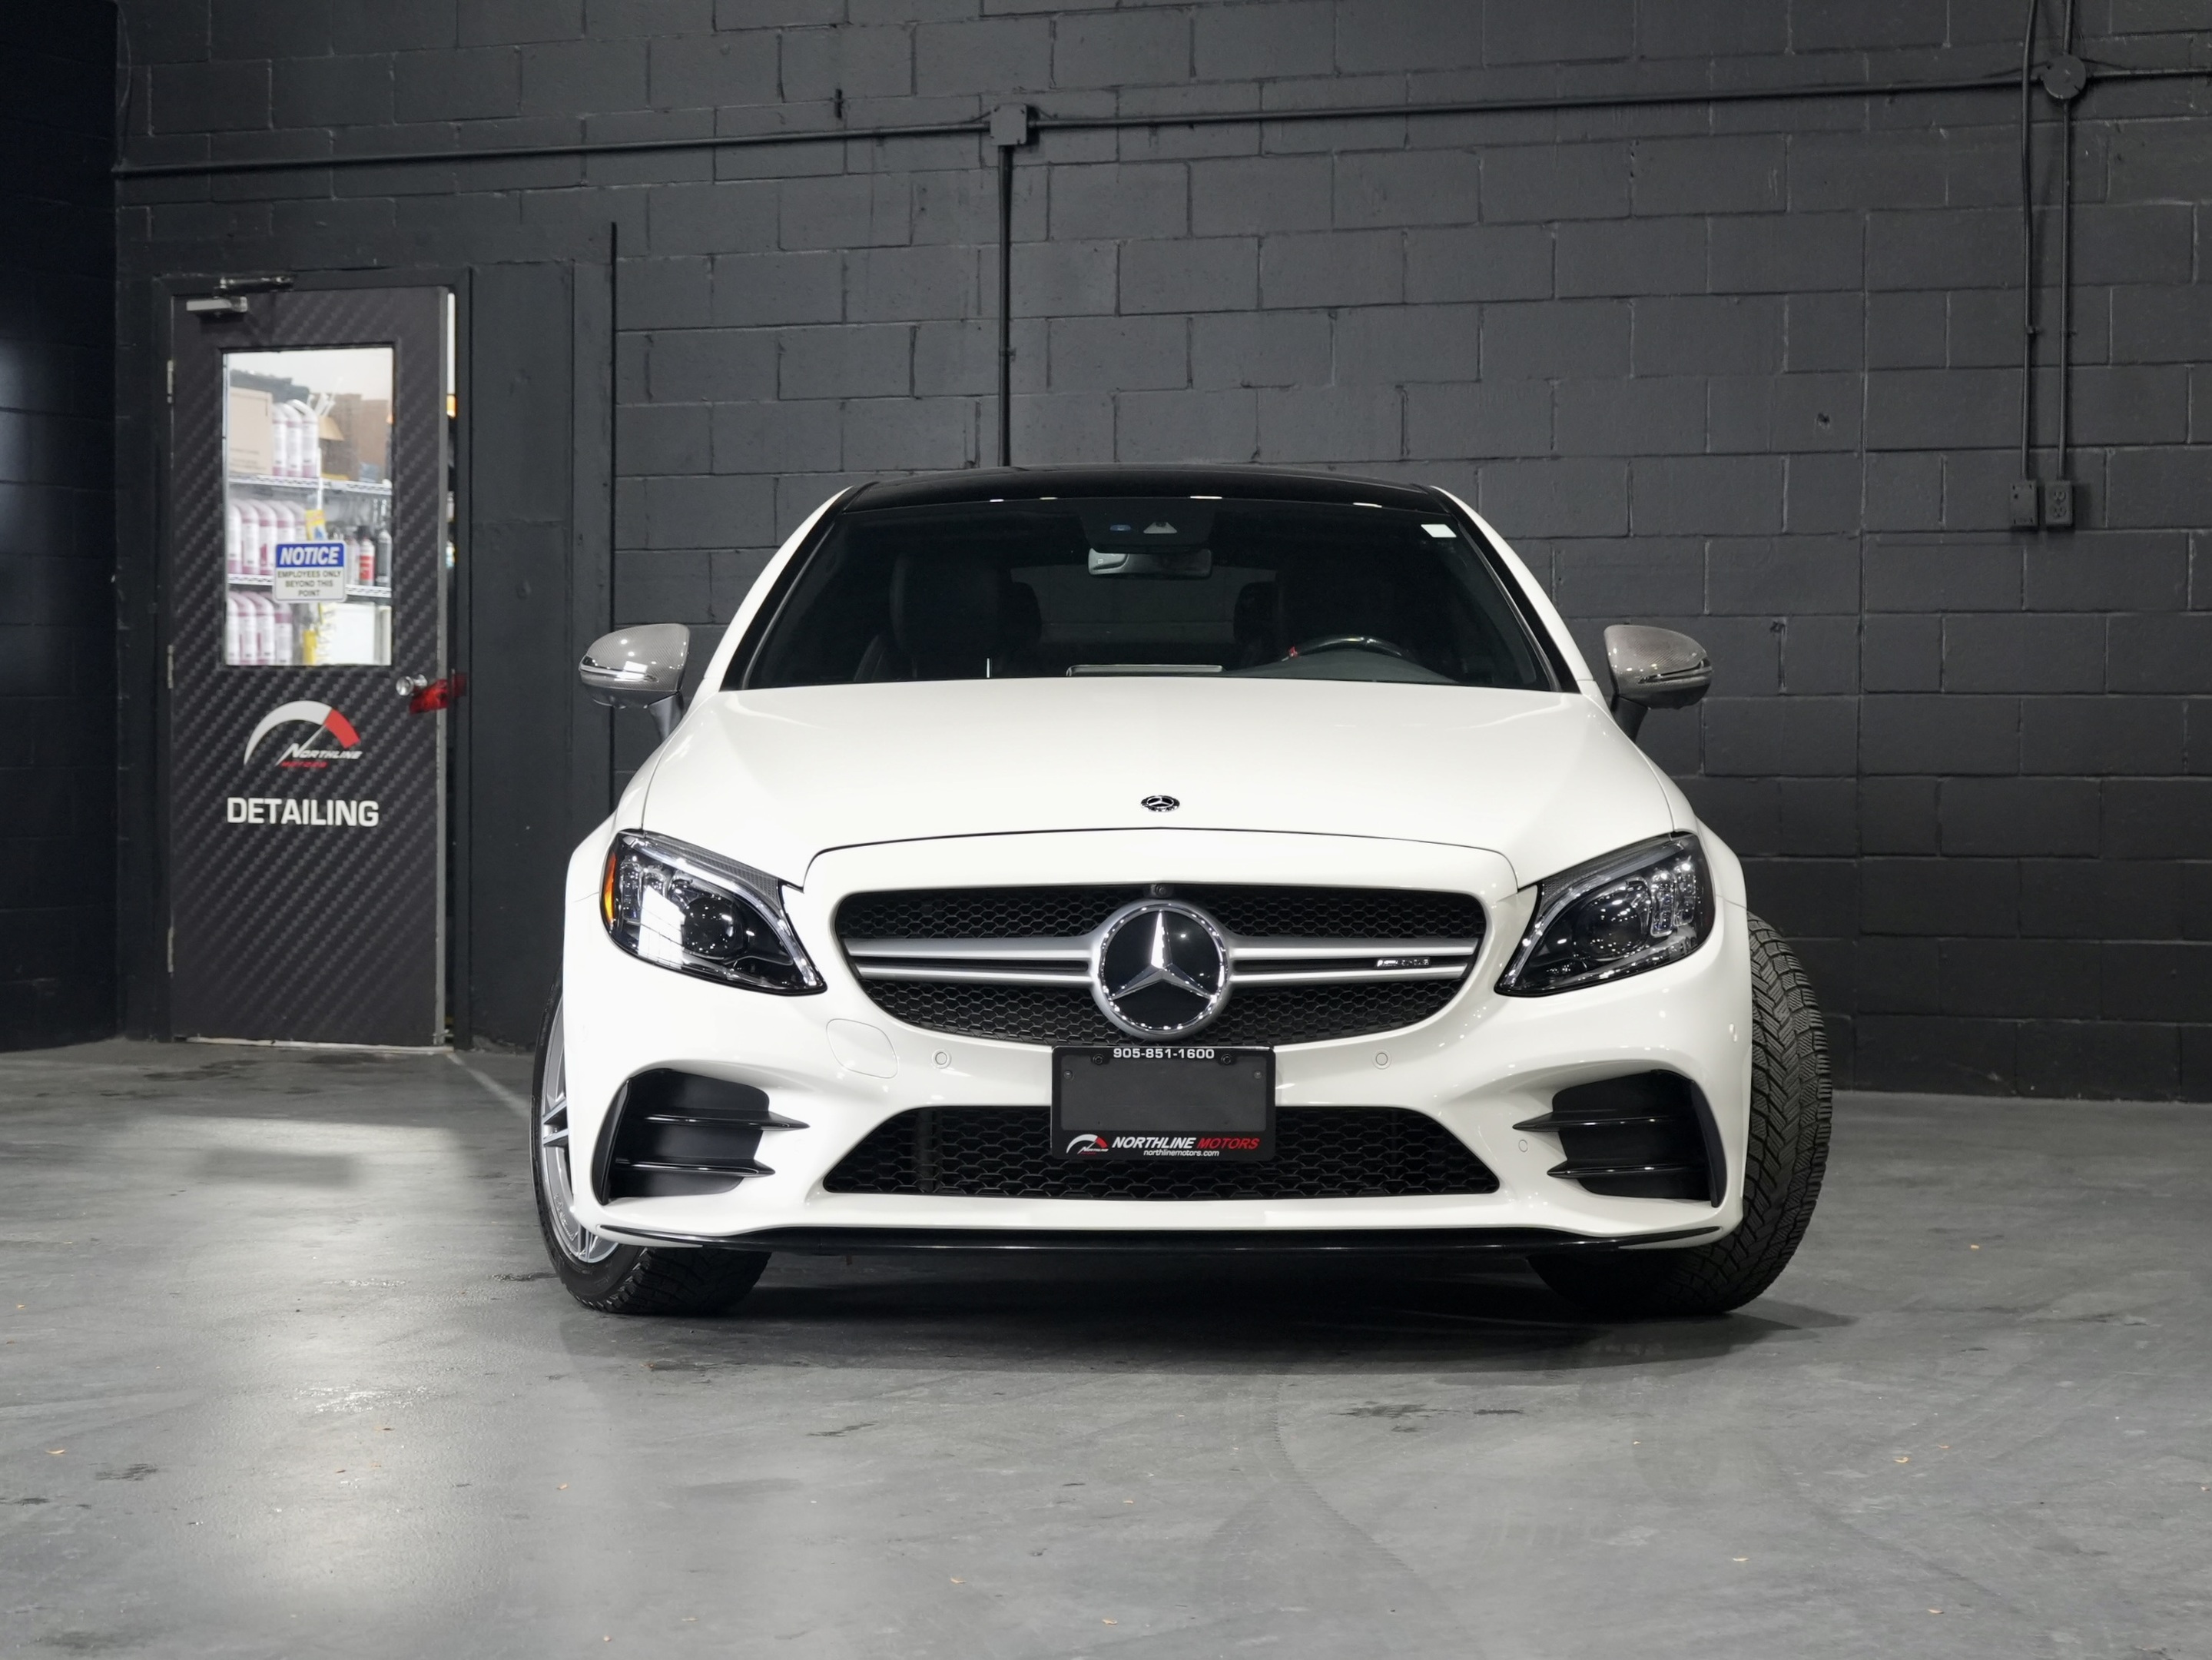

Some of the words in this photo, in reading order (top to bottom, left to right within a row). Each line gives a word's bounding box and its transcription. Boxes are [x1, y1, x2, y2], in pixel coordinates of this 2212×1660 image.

[279, 546, 340, 566] NOTICE
[285, 579, 315, 588] BEYOND
[227, 797, 380, 827] DETAILING
[1113, 1047, 1215, 1060] 905-851-1600
[1112, 1136, 1196, 1149] NORTHLINE
[1196, 1137, 1261, 1150] MOTORS
[1143, 1149, 1220, 1157] northlinemotors.com
